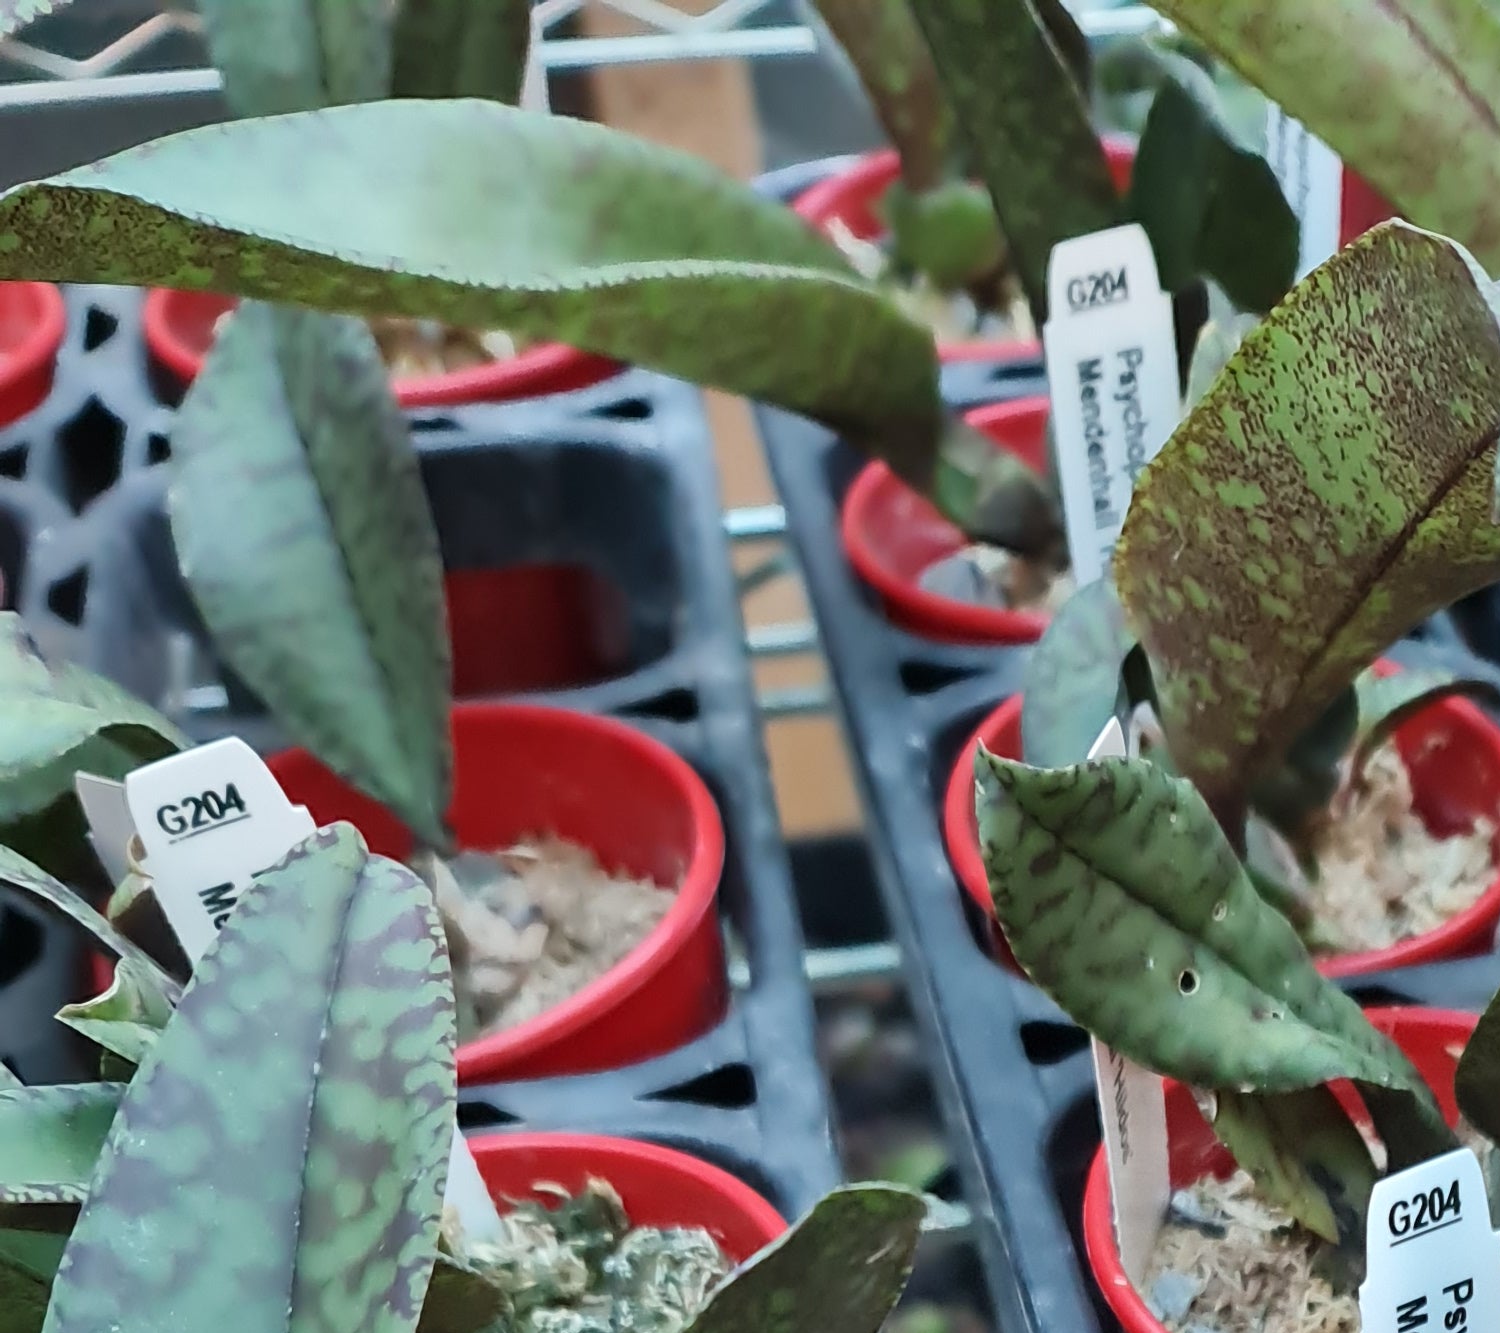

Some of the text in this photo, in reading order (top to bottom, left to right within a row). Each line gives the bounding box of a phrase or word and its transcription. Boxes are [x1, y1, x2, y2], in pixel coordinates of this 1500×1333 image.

[1066, 265, 1129, 308] G204
[156, 782, 248, 837] G204
[1388, 1179, 1463, 1238] G204
